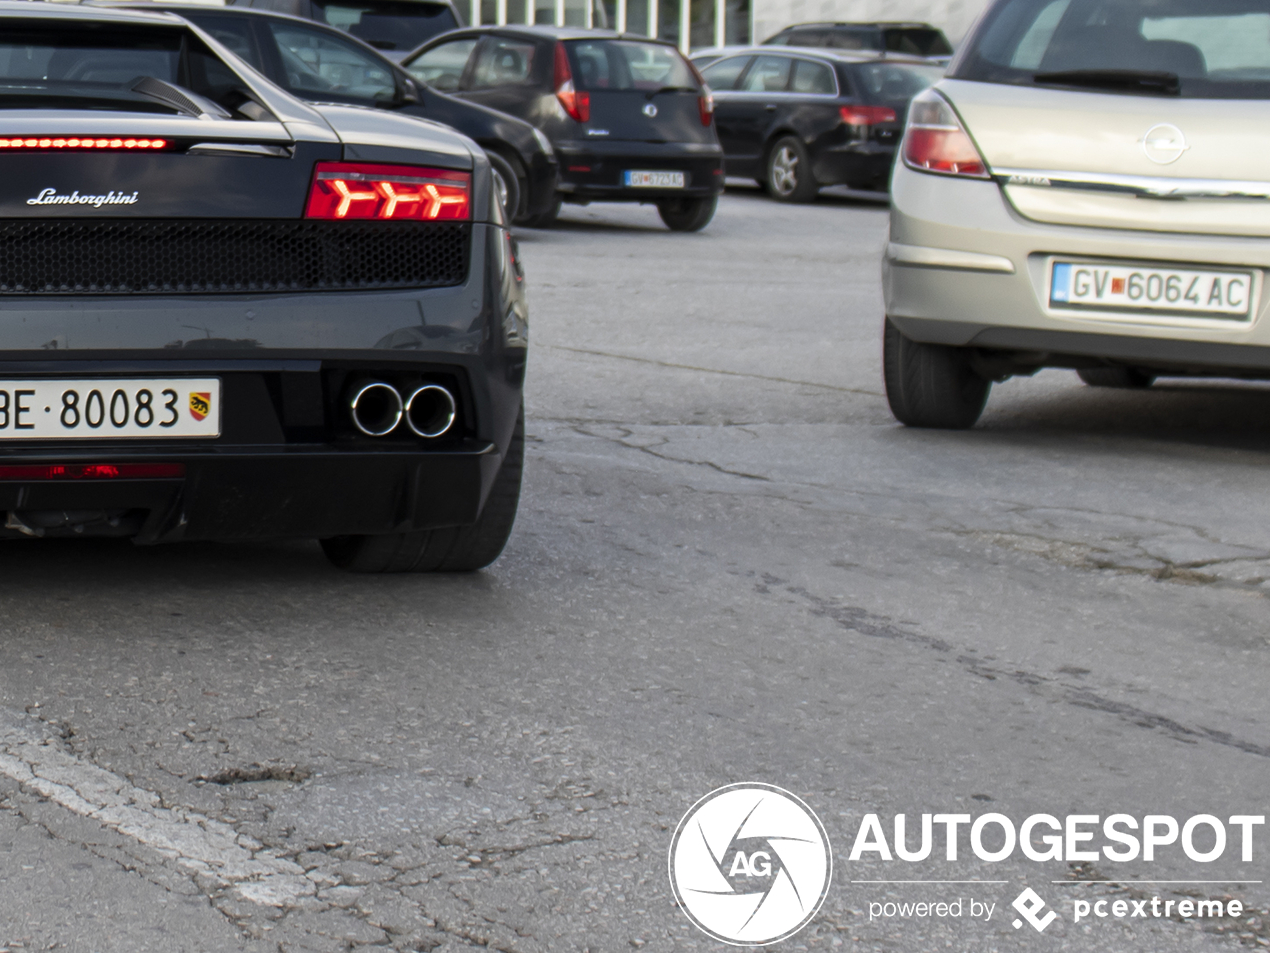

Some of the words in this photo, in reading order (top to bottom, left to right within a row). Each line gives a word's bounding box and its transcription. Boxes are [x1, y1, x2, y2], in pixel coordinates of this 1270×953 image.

[26, 187, 139, 208] Lamborghini
[1073, 269, 1110, 299] GV
[1127, 272, 1201, 304] 6064
[1207, 277, 1245, 308] AC
